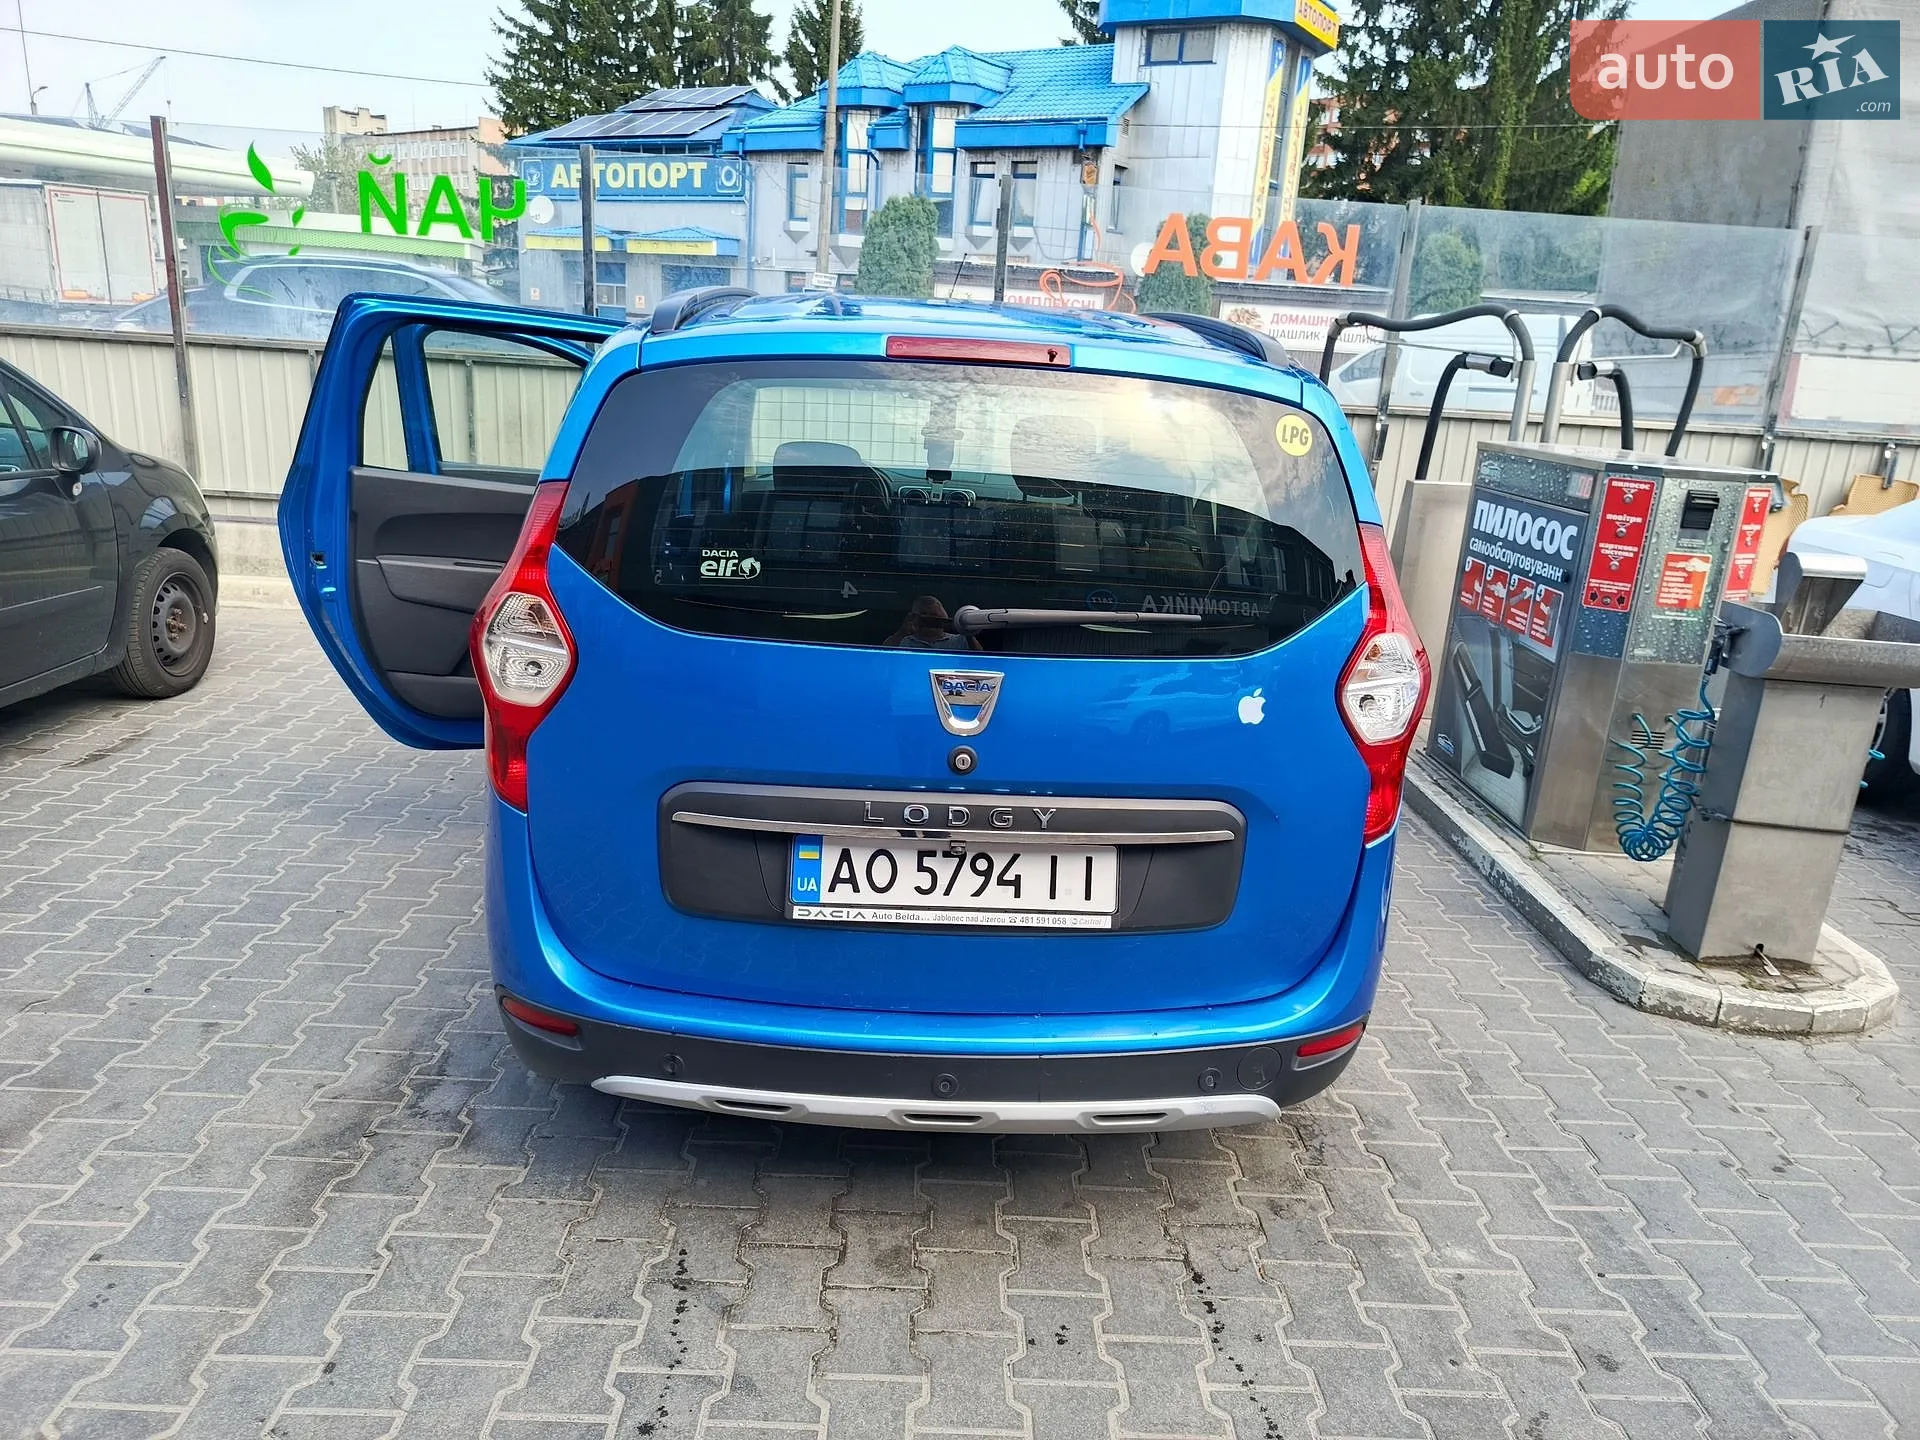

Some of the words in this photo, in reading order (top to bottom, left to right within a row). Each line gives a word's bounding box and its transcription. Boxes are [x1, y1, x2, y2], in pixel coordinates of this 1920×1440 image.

[550, 161, 708, 189] АВТОПОРТ
[1004, 293, 1098, 309] ОМПЛЕКСНІ
[1281, 423, 1309, 447] LPG
[1472, 499, 1578, 560] ПИЛОСОС
[701, 549, 739, 558] DACIA
[1469, 537, 1564, 583] самообслуговуванн
[700, 558, 740, 577] elf
[943, 680, 992, 692] DACIA
[863, 801, 1057, 830] LODGY
[797, 877, 817, 892] UA
[871, 911, 893, 921] Auto
[965, 915, 979, 923] nad
